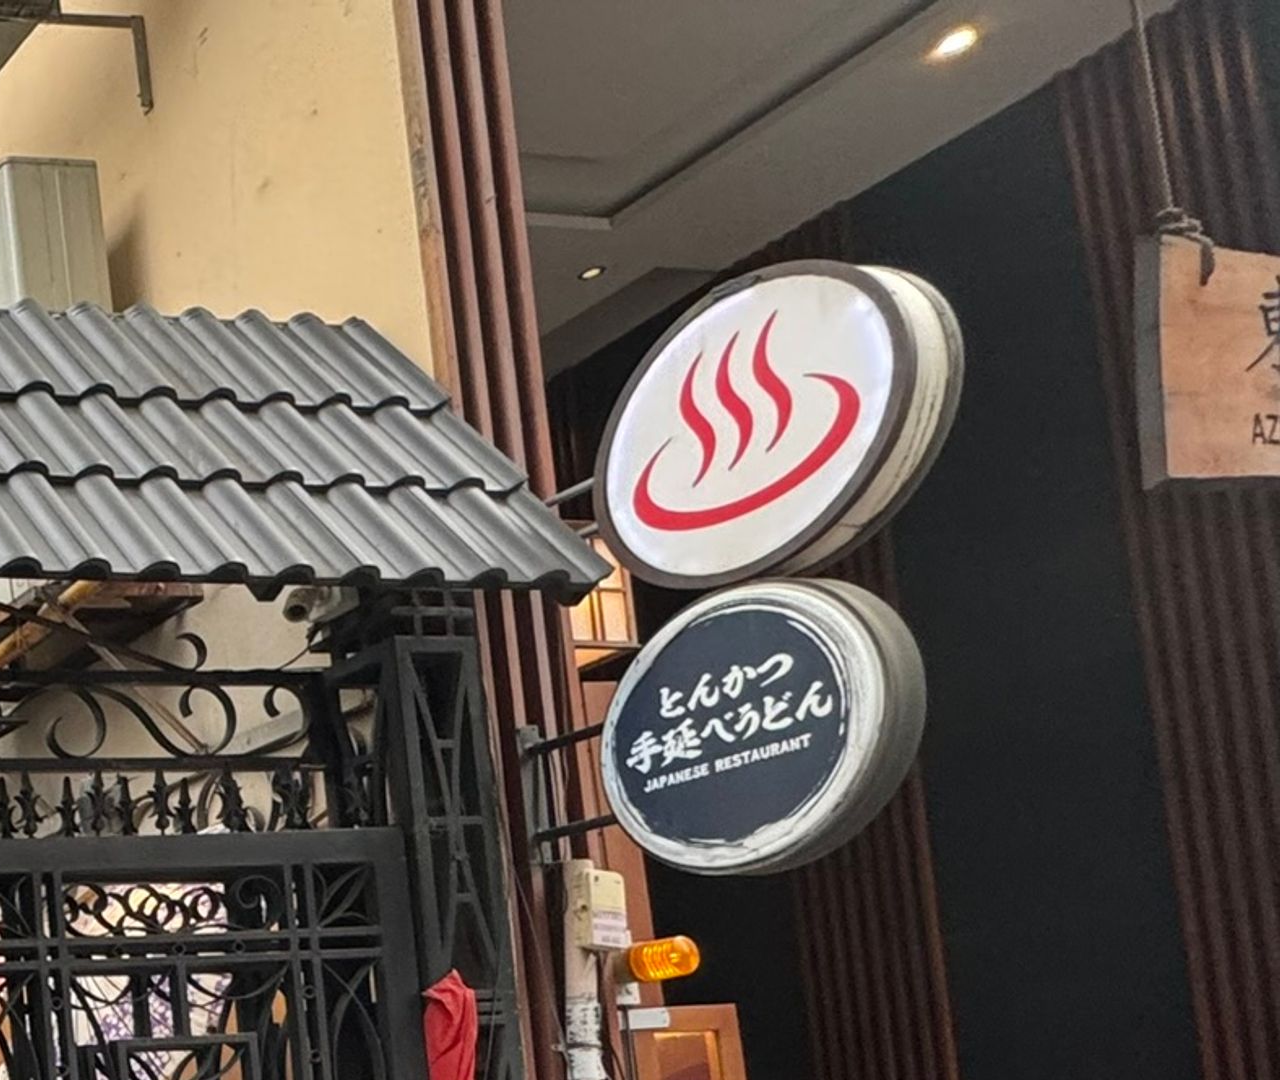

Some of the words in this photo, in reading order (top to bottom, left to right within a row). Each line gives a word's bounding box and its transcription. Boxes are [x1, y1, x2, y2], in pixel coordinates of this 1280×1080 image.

[658, 652, 795, 719] とんかつ
[625, 680, 834, 775] 手延べうどん
[643, 762, 710, 794] JAPANESE
[714, 733, 813, 772] RESTAURANT
